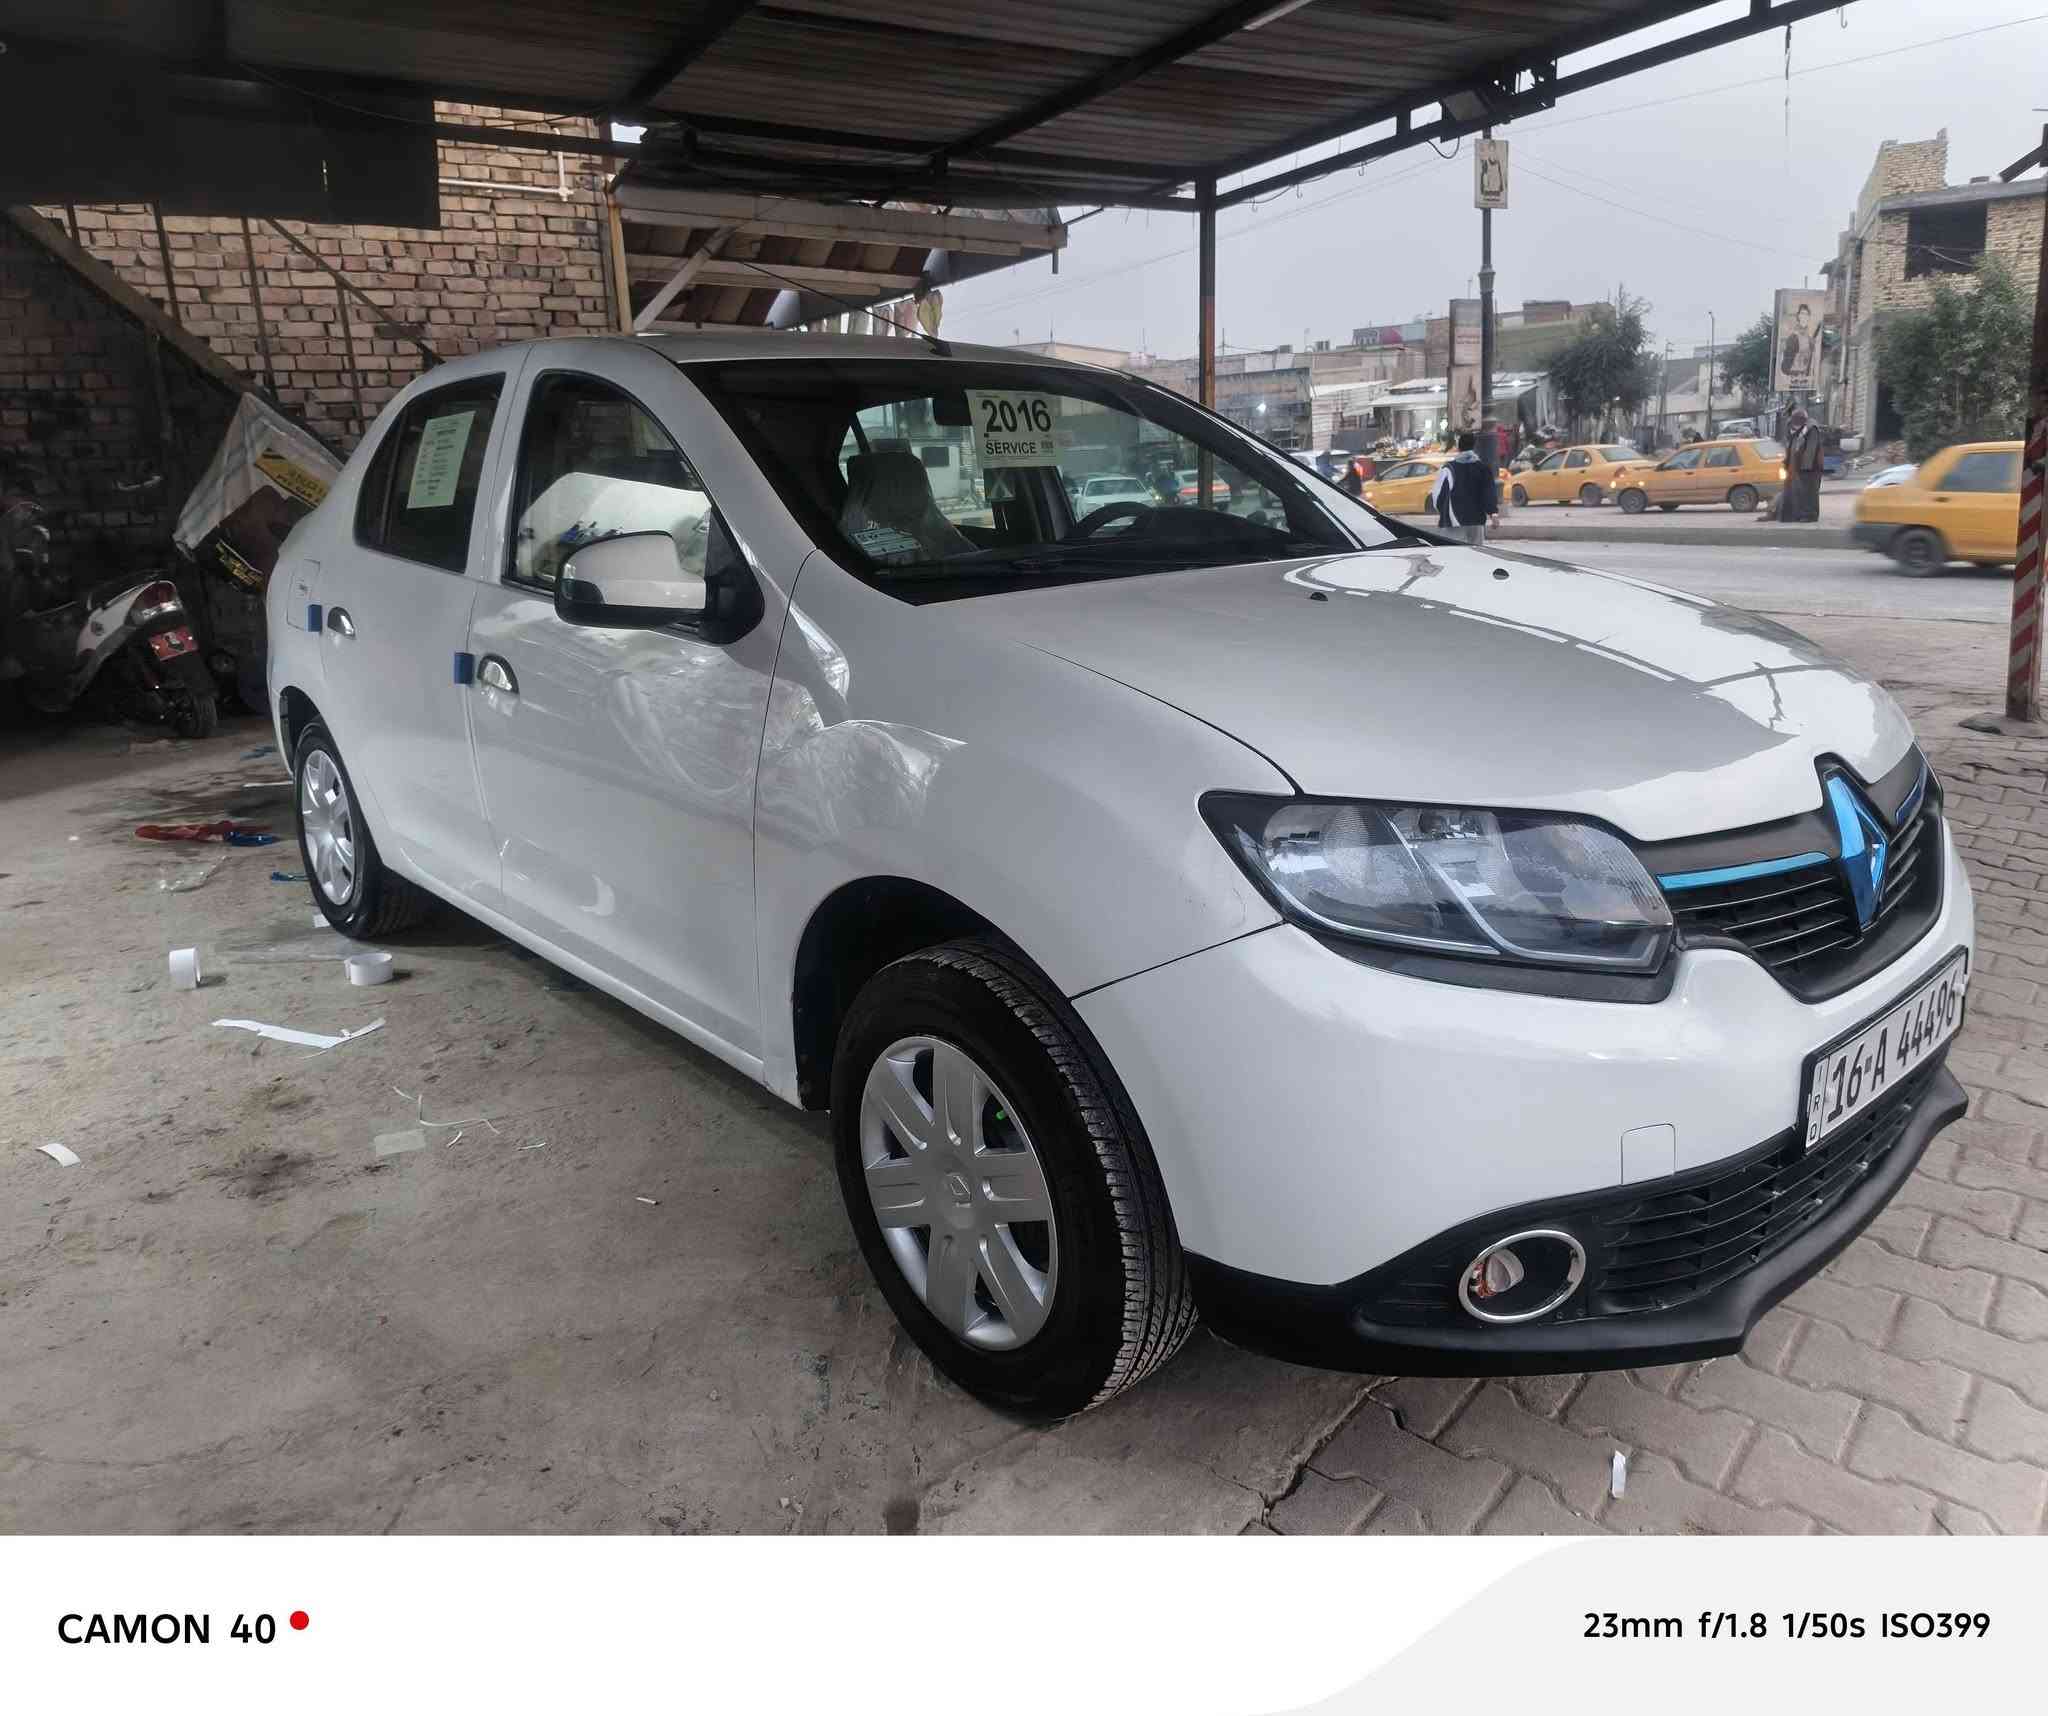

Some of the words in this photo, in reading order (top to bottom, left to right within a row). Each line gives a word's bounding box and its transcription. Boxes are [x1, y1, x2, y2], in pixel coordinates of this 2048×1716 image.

[982, 399, 1052, 433] 2016
[985, 440, 1037, 455] SERVICE
[1827, 1042, 1865, 1123] 16
[1871, 1026, 1888, 1092] A
[1896, 969, 1957, 1067] 44496
